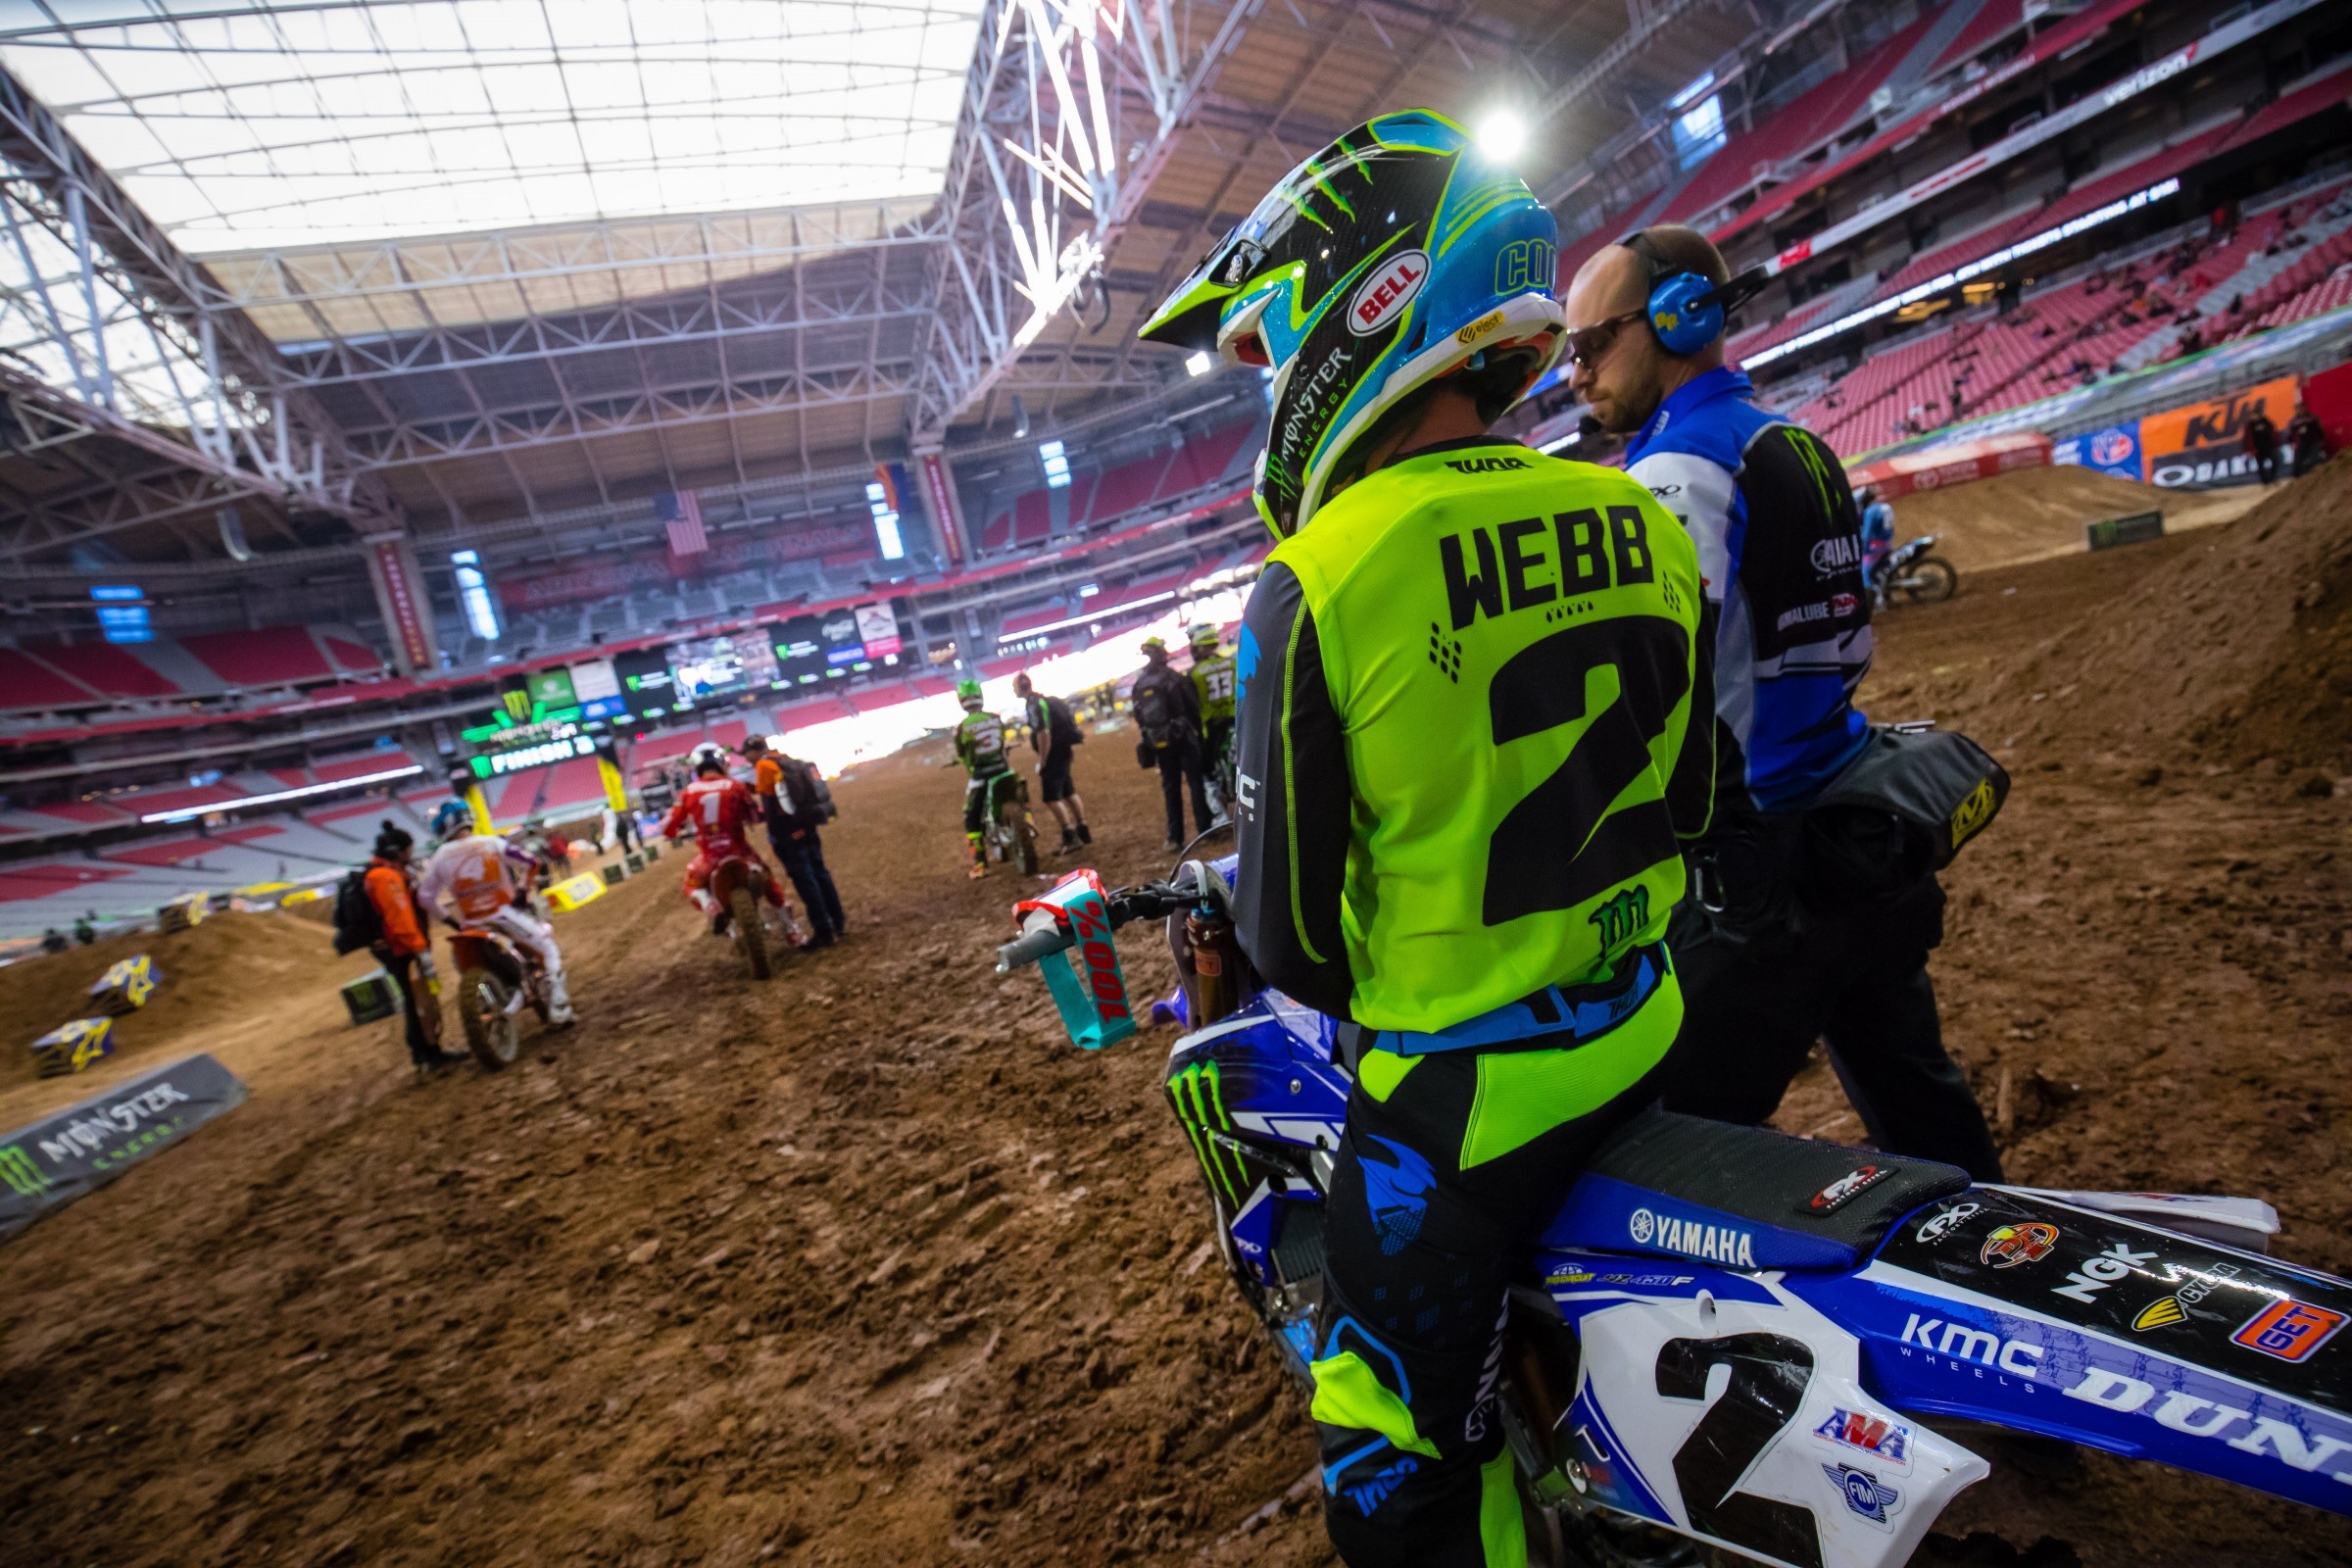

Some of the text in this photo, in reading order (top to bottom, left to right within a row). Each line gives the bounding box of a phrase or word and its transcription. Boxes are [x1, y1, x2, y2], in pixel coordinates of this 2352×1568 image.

[2103, 54, 2188, 107] verizon
[1357, 264, 1421, 324] BELL
[1475, 314, 1500, 333] eject
[1282, 346, 1352, 462] MONSTER
[1298, 377, 1348, 459] ENERGY
[1439, 505, 1654, 632] WEBB
[1204, 670, 1234, 702] 33
[974, 727, 1001, 755] 3
[1482, 614, 1690, 927] 2
[700, 792, 720, 824] 1
[1071, 900, 1128, 1025] 100%
[38, 1082, 189, 1163] MONSTER
[1656, 1215, 1756, 1268] YAMAHA
[2050, 1244, 2159, 1304] NGK
[2256, 1306, 2322, 1350] GET
[1900, 1347, 2035, 1394] WHEELS
[1654, 1330, 1827, 1568] 2
[1815, 1406, 1907, 1461] AMA
[2063, 1367, 2352, 1487] DUN
[1848, 1481, 1876, 1506] FIM
